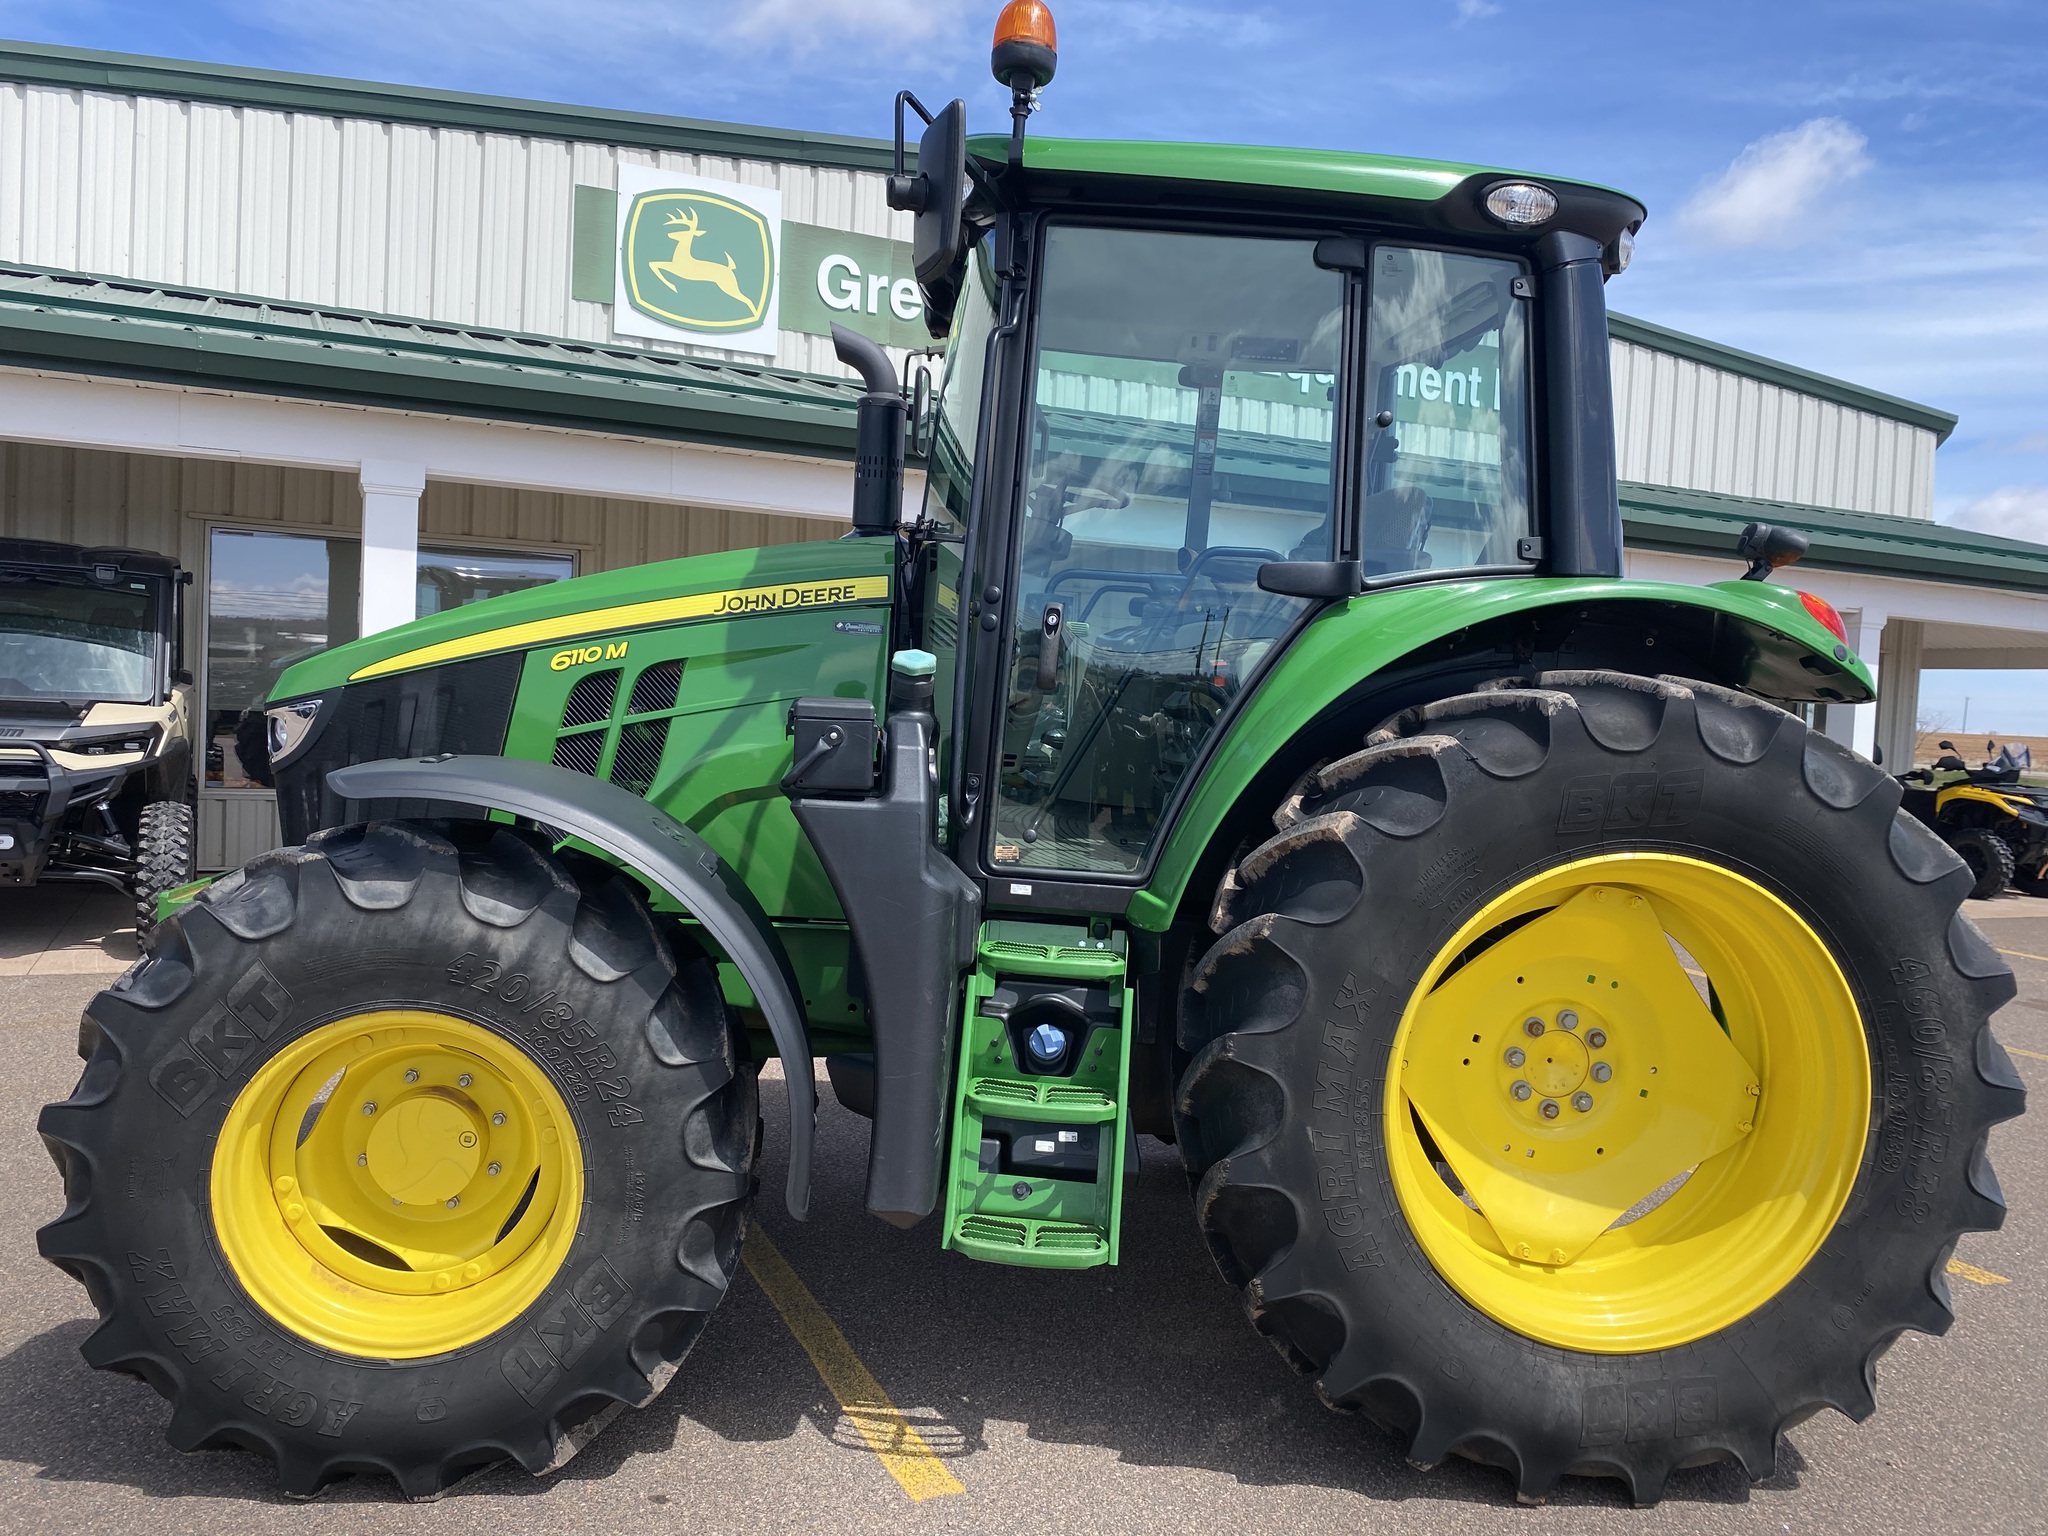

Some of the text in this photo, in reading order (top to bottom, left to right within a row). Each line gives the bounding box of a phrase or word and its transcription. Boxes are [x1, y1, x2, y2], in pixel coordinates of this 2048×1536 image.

[817, 254, 923, 320] Gre
[713, 585, 856, 614] JOHN DEERE
[1558, 775, 1702, 830] BKT
[1417, 846, 1460, 886] TUBELESS
[152, 967, 286, 1113] BKT
[446, 951, 646, 1128] 420/85R24
[1889, 957, 1954, 1225] 460/85R38
[508, 1260, 630, 1401] BKT
